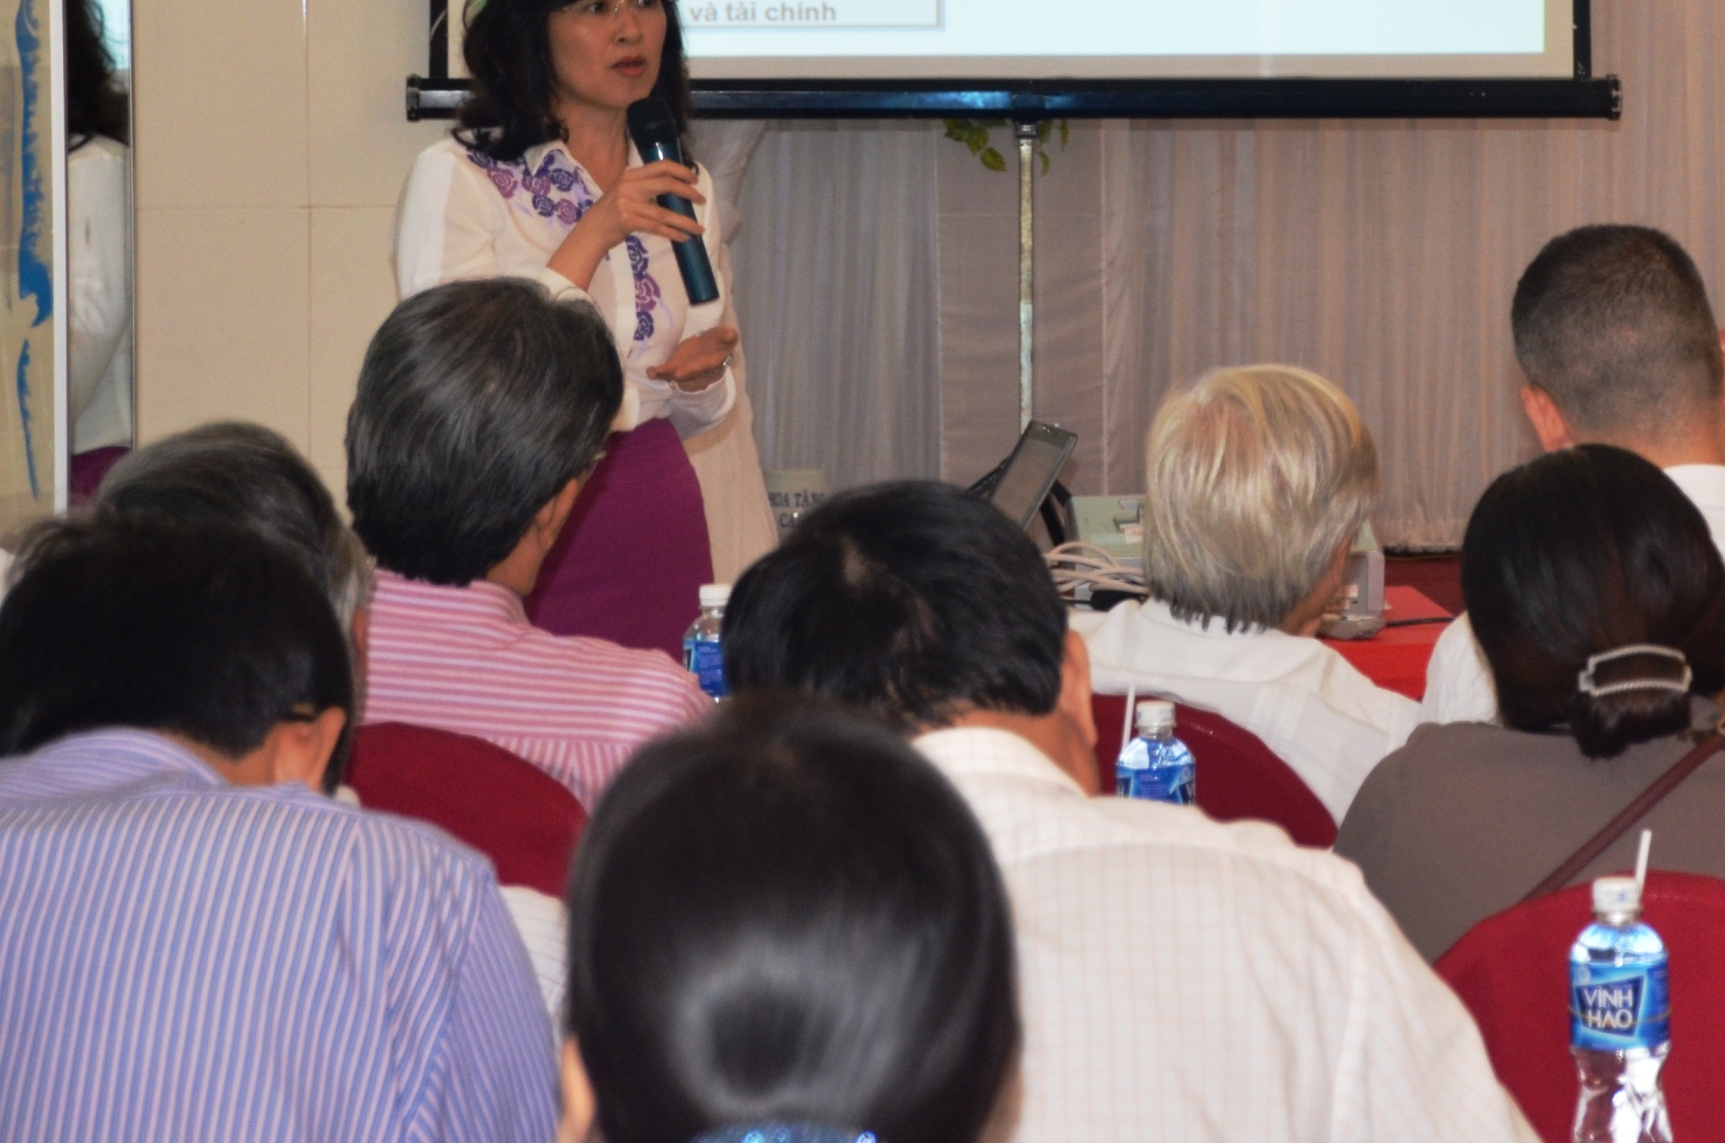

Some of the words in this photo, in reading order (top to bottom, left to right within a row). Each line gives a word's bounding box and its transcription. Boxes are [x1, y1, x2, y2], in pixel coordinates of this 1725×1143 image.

[689, 2, 719, 22] và
[724, 0, 757, 22] tài
[765, 0, 836, 22] chính
